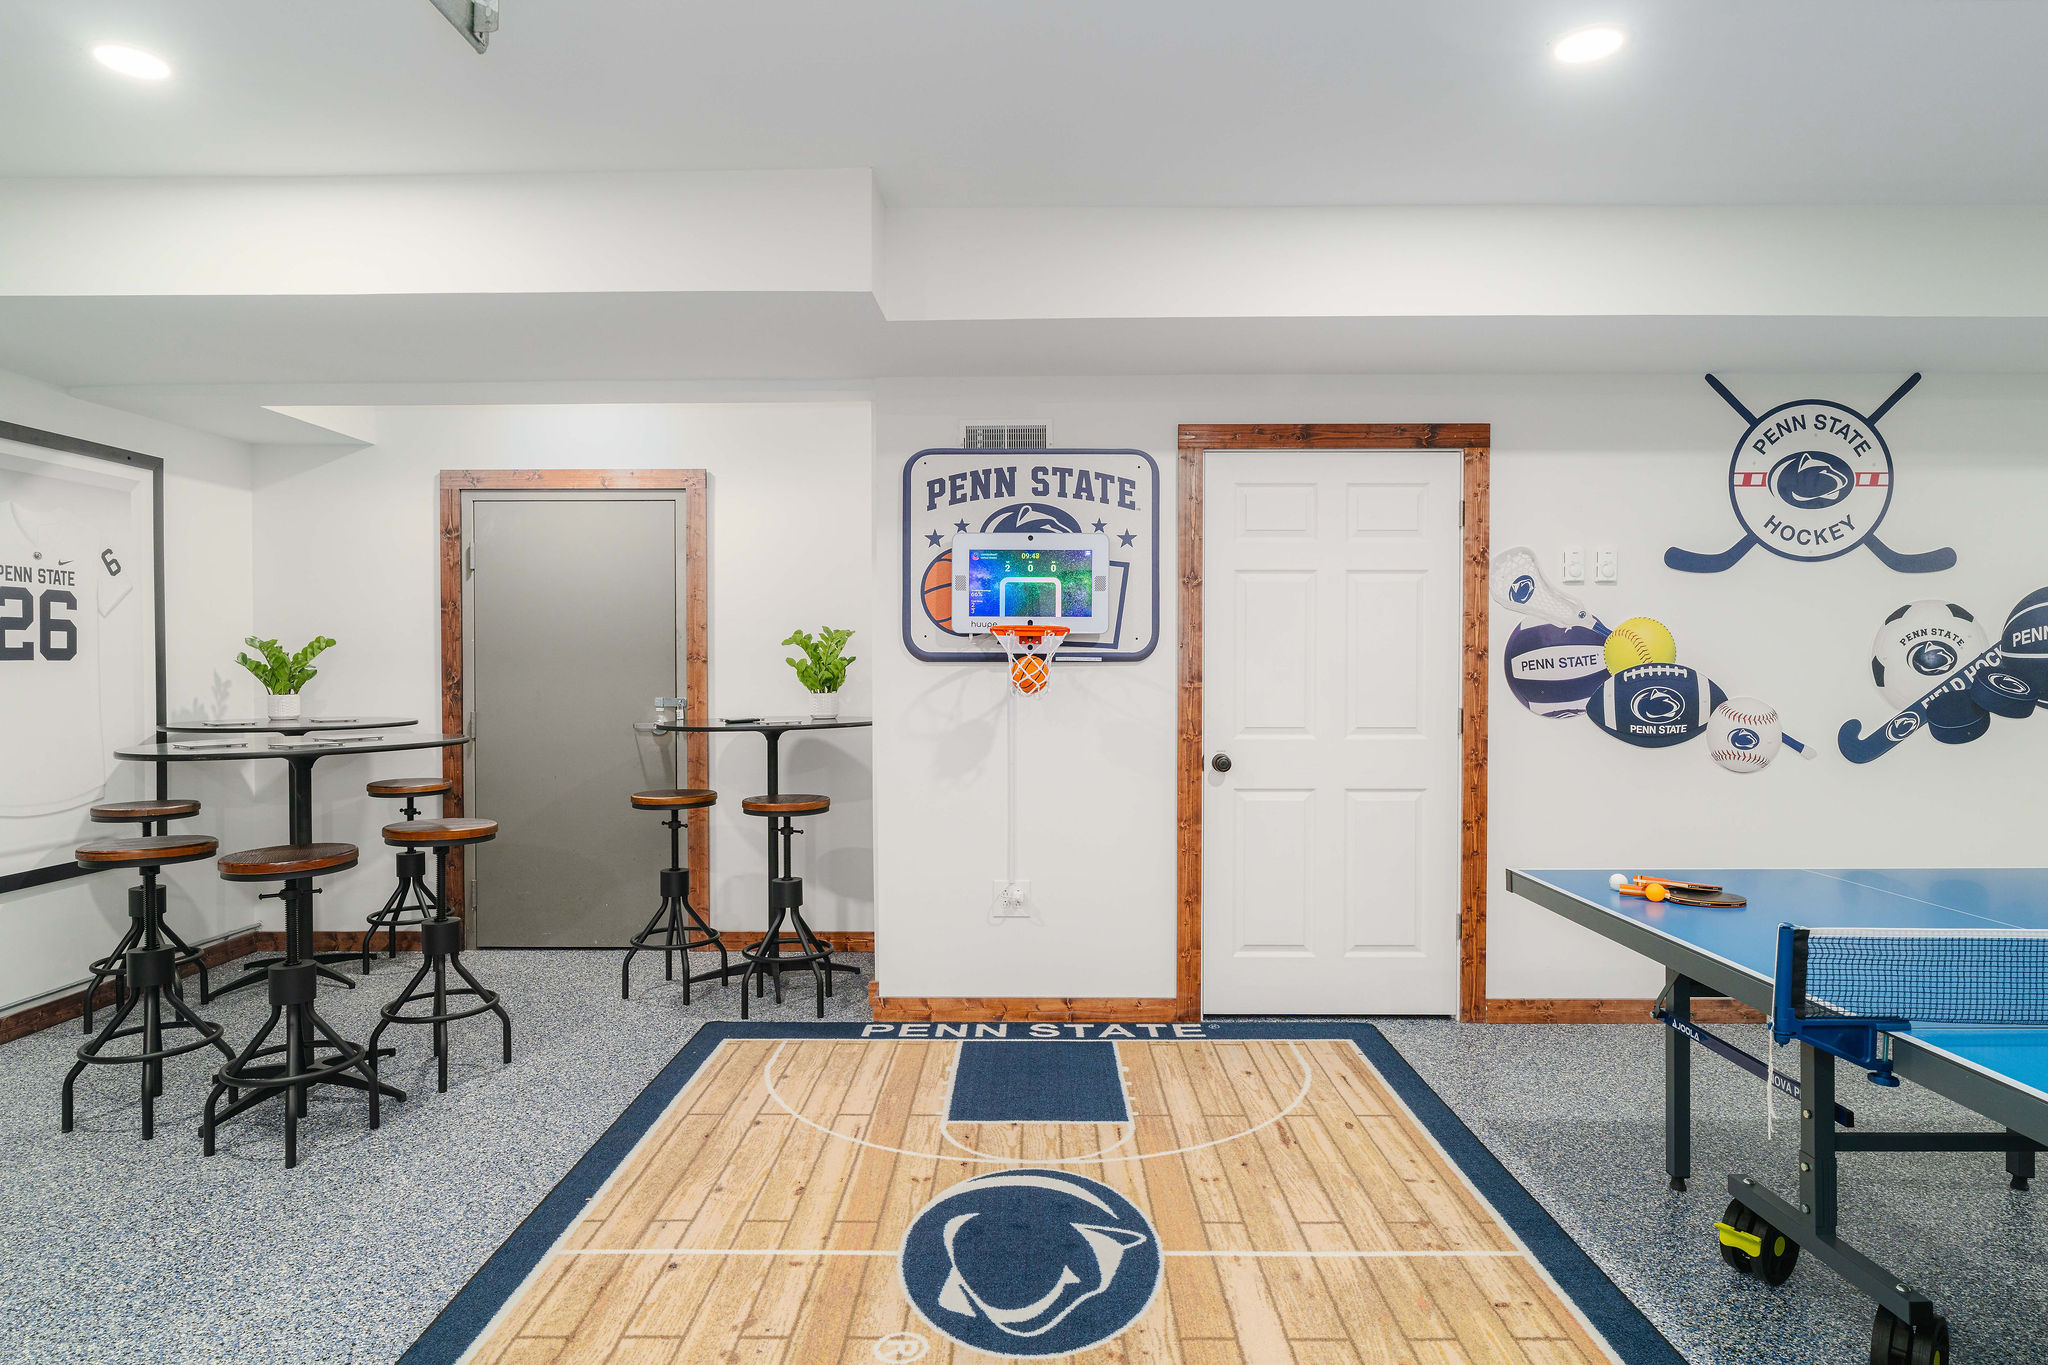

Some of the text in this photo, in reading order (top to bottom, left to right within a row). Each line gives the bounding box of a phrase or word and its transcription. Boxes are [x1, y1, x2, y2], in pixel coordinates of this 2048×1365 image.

[1752, 414, 1872, 457] PENN STATE
[926, 465, 1136, 512] PENN STATE
[1763, 514, 1855, 545] HOCKEY
[101, 548, 121, 576] 6
[1021, 552, 1040, 560] 09:48
[38, 568, 75, 586] STATE
[0, 586, 78, 661] 26
[970, 620, 998, 629] huupe
[1899, 628, 1965, 647] PENN STATE
[1521, 655, 1597, 672] PENN STATE
[1630, 724, 1687, 734] PENN STATE
[860, 1023, 1208, 1038] PENN STATE
[1677, 1022, 1700, 1041] JOOLA
